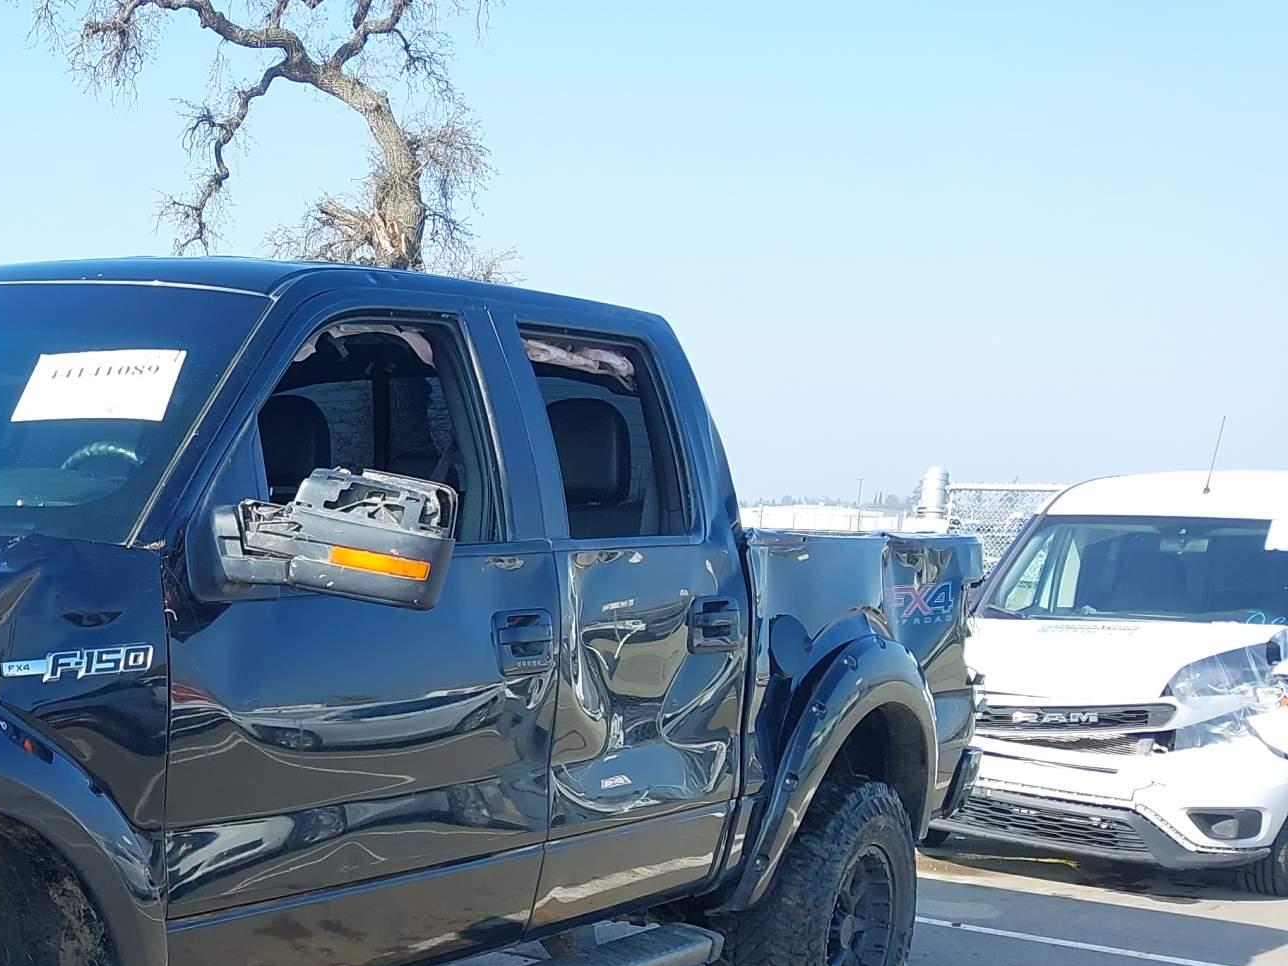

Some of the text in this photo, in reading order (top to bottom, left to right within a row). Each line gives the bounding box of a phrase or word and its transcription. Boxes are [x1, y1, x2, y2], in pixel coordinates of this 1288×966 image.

[893, 580, 954, 618] FX4
[7, 662, 32, 673] FX4
[43, 643, 155, 683] F-150
[1012, 711, 1099, 724] RAM
